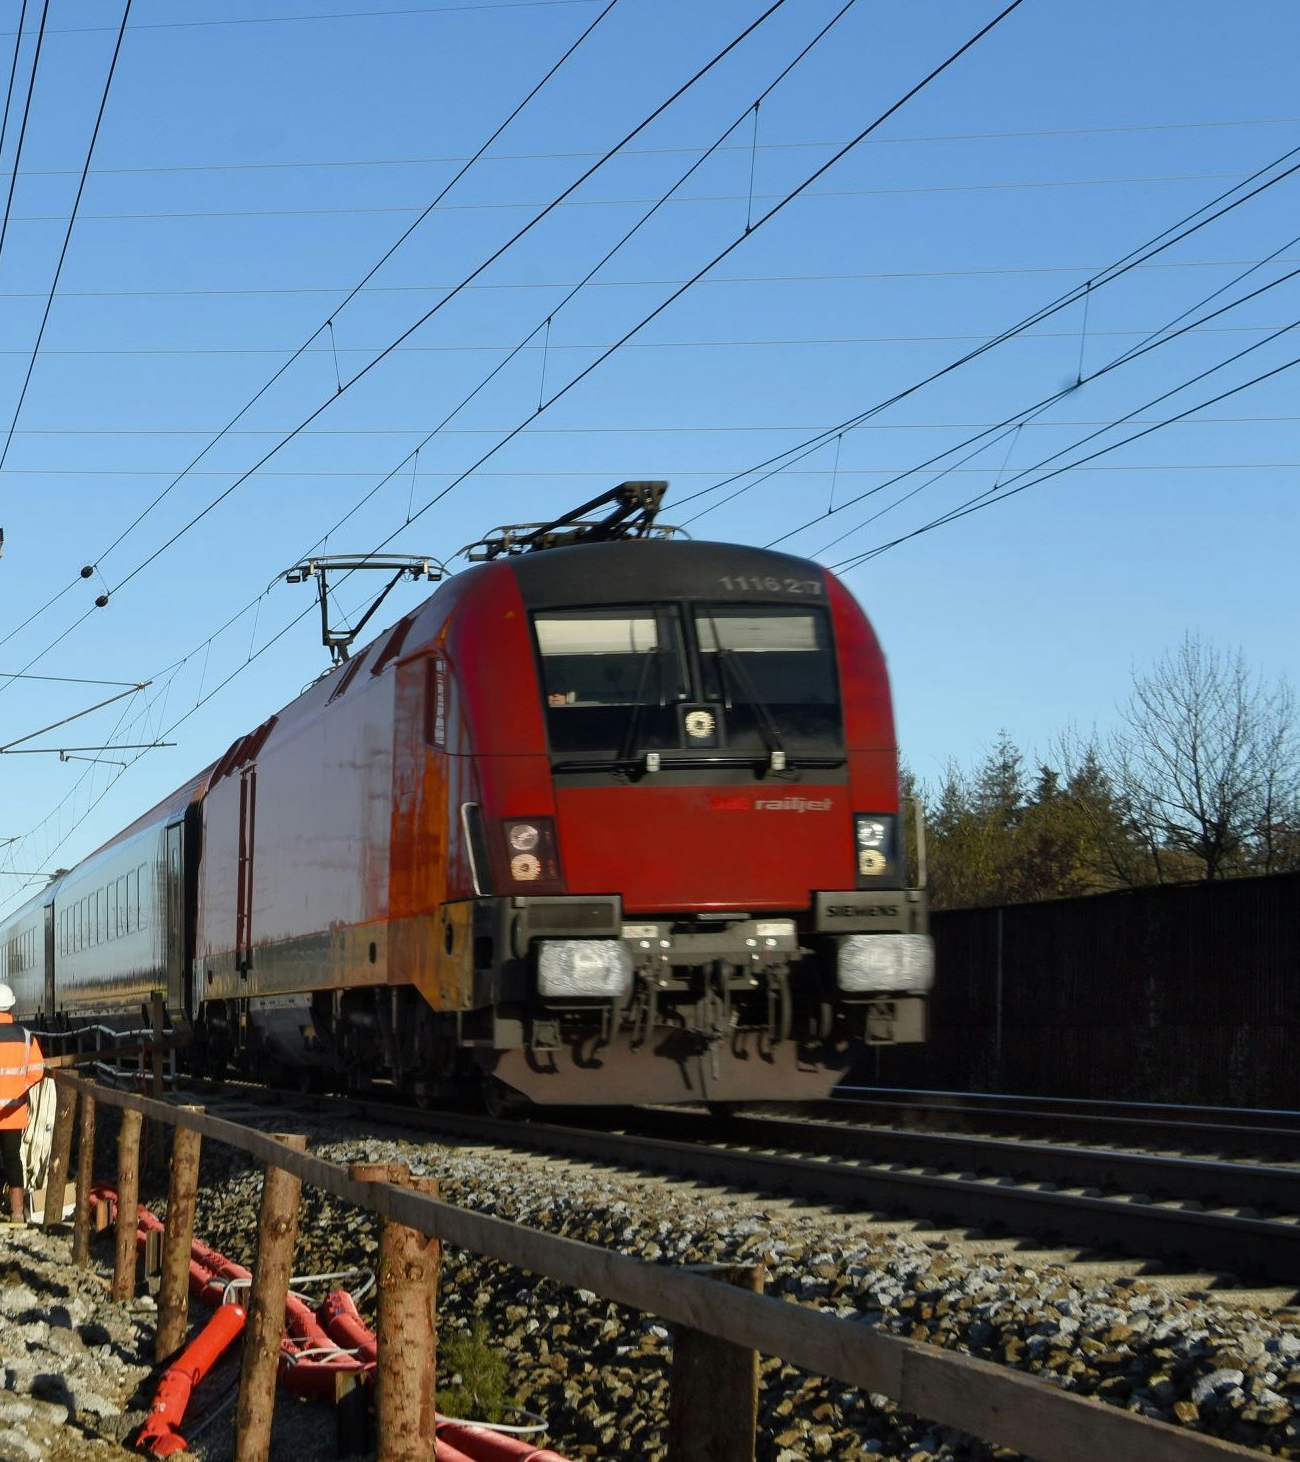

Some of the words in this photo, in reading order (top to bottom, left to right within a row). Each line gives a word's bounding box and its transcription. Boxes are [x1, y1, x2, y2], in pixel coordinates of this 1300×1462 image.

[718, 575, 782, 592] 1116
[754, 796, 834, 813] railjet
[826, 904, 899, 917] SIEMENS
